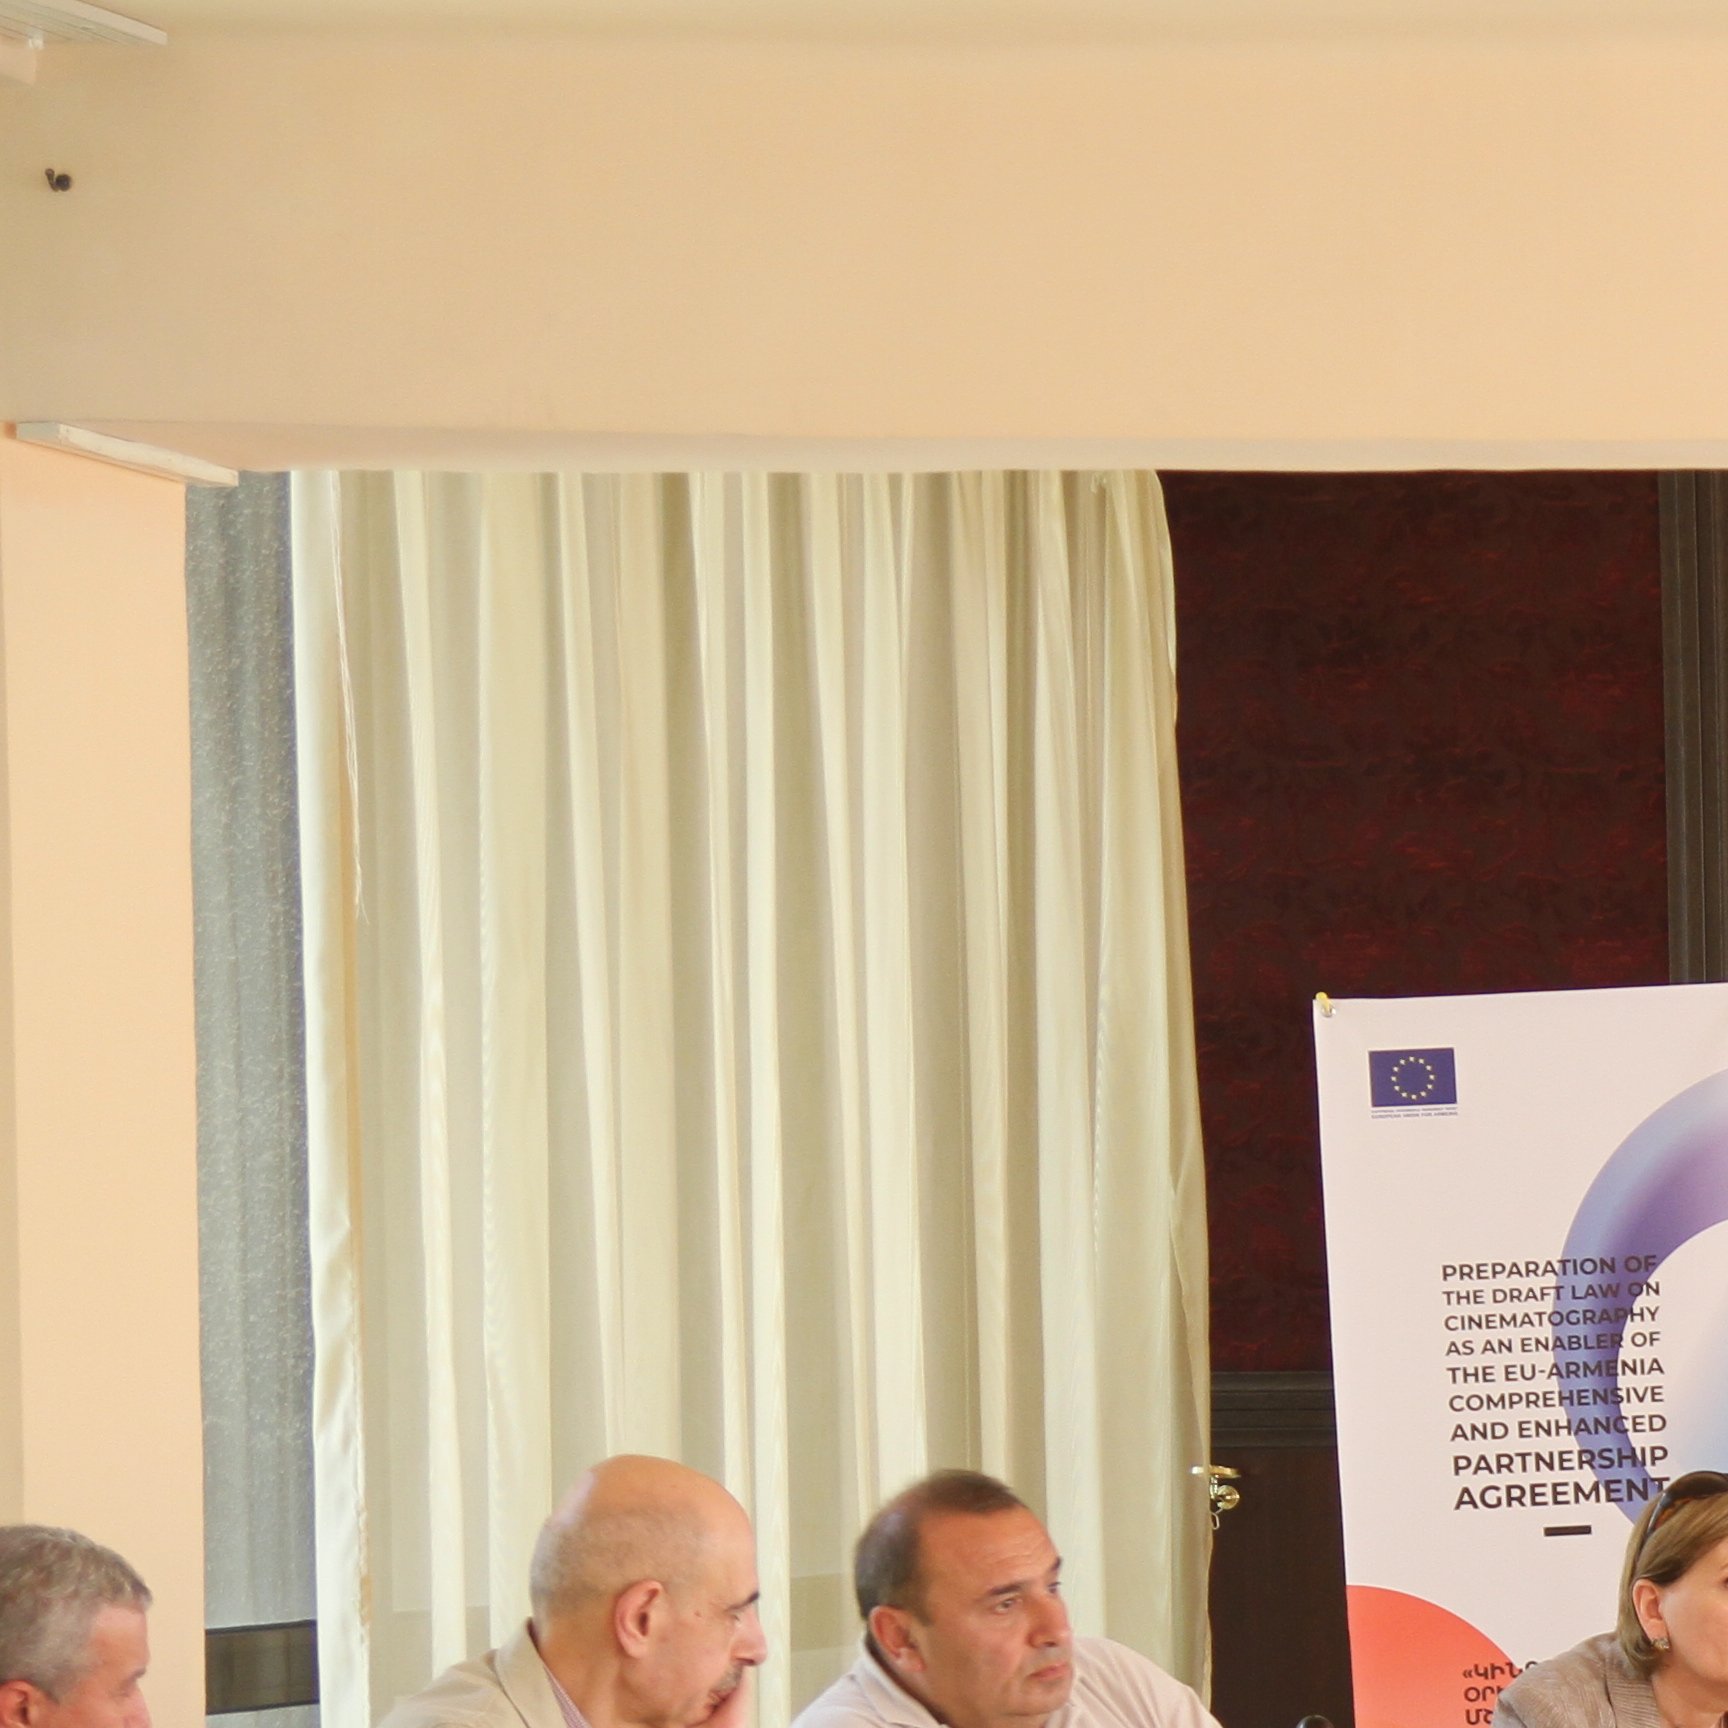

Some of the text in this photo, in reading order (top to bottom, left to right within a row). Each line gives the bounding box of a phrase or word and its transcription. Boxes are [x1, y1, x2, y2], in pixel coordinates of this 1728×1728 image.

[1442, 1254, 1658, 1282] PREPARATION OF
[1442, 1281, 1660, 1306] THE DRAFT LAW ON
[1444, 1306, 1660, 1332] CINEMATOGRAPHY
[1445, 1331, 1662, 1357] AS AN ENABLER OF
[1446, 1357, 1665, 1385] THE EU-ARMENIA
[1448, 1385, 1664, 1412] COMPREHENSIVE
[1450, 1414, 1667, 1441] AND ENHANCED
[1453, 1445, 1669, 1476] PARTNERSHIP
[1453, 1476, 1671, 1511] AGREEMENT
